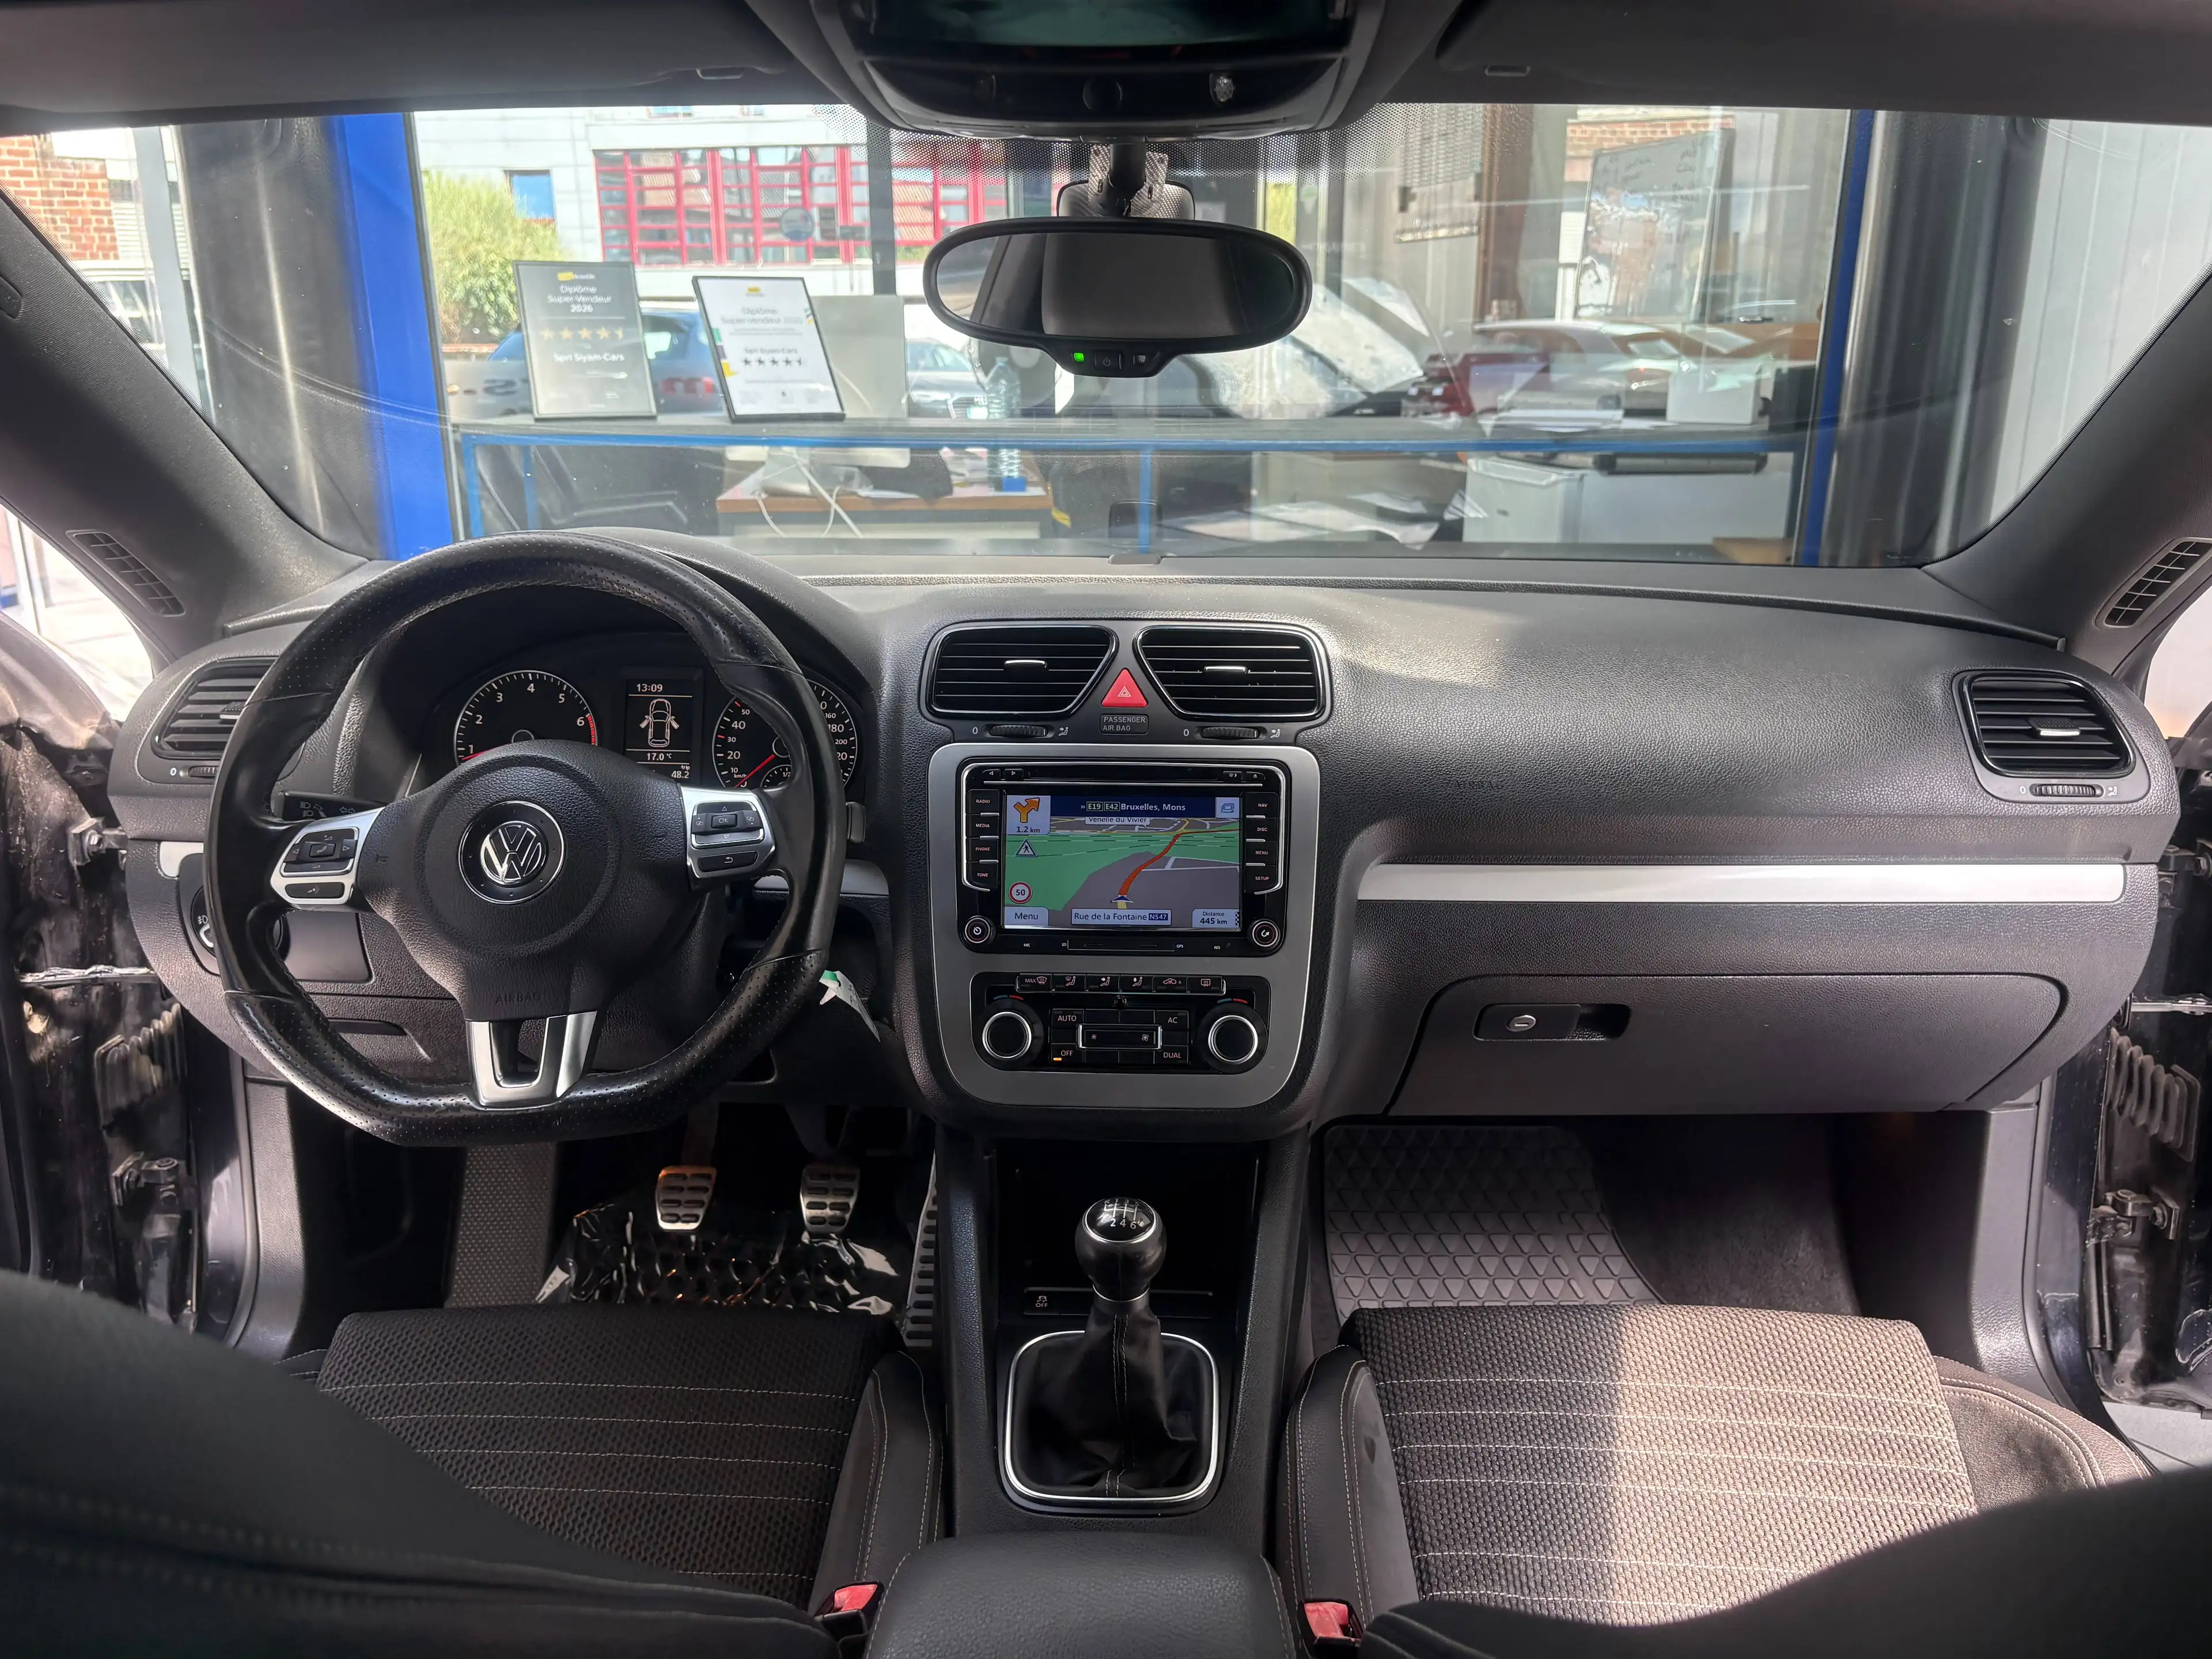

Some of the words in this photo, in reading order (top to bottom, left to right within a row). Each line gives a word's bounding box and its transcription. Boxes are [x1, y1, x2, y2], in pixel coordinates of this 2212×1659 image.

[527, 683, 535, 693] 4
[637, 683, 662, 692] 13:09
[496, 693, 503, 702] 3
[558, 694, 565, 703] 5
[475, 715, 483, 724] 2
[577, 717, 585, 726] 6
[731, 721, 746, 729] 40
[828, 724, 844, 733] 180
[468, 744, 474, 753] 1
[727, 751, 741, 759] 20
[836, 752, 847, 760] 20
[671, 770, 690, 778] 48.2
[1121, 803, 1160, 812] Bruxelles,
[1014, 912, 1039, 921] Menu
[1110, 1218, 1116, 1227] 2
[1119, 1218, 1126, 1228] 4
[1130, 1221, 1137, 1229] 6
